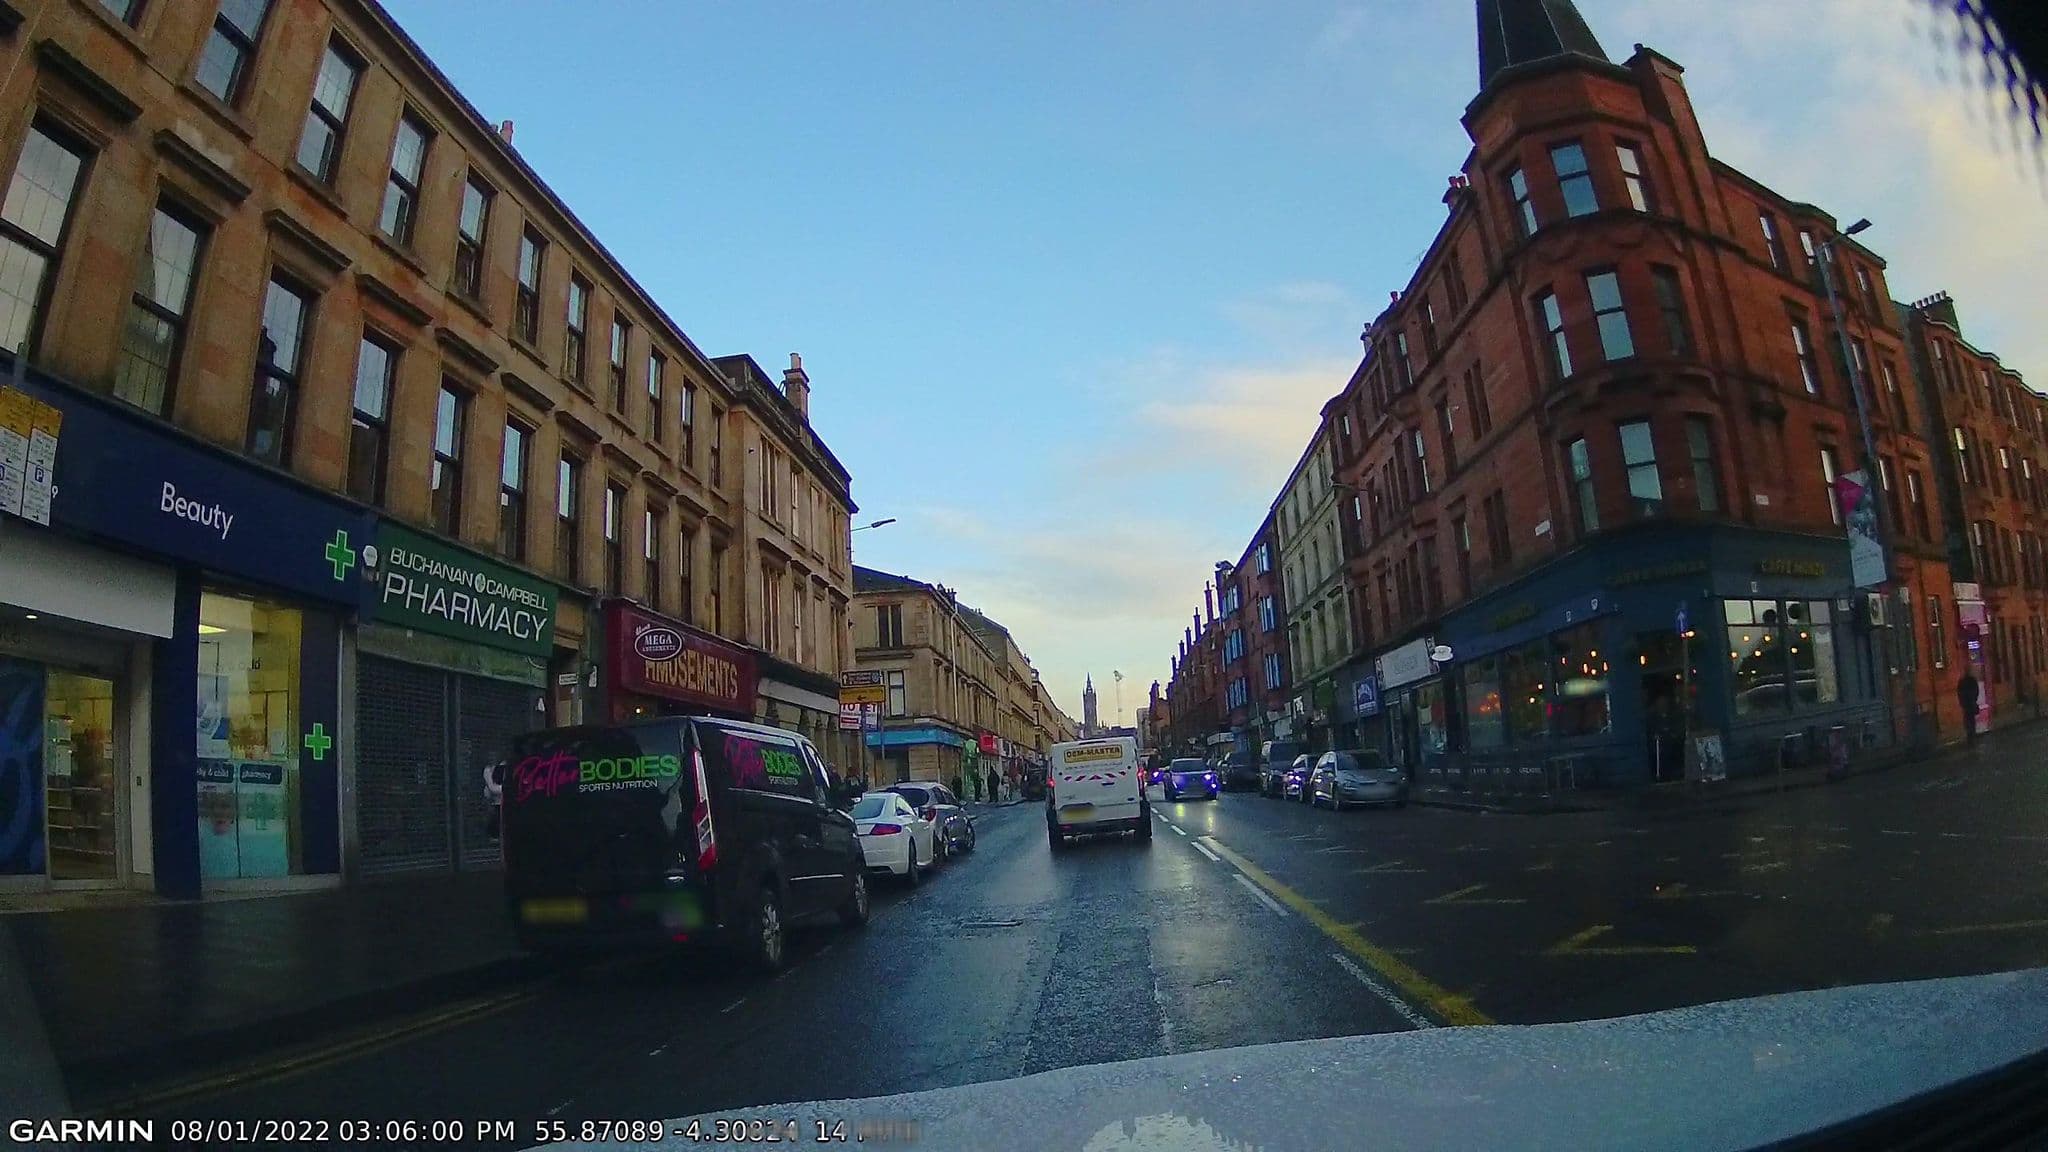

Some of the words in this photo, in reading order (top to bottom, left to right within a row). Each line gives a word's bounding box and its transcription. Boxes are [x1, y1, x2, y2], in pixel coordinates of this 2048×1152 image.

[160, 481, 234, 540] Beauty
[390, 547, 474, 588] BUCHANAN
[486, 579, 549, 611] CAMPBELL
[383, 571, 547, 642] PHARMACY
[644, 634, 673, 645] MEGA
[645, 649, 738, 699] AMUSEMENTS
[578, 782, 611, 793] SPORTS
[612, 779, 658, 791] NUTRITION
[579, 753, 681, 782] BODIES
